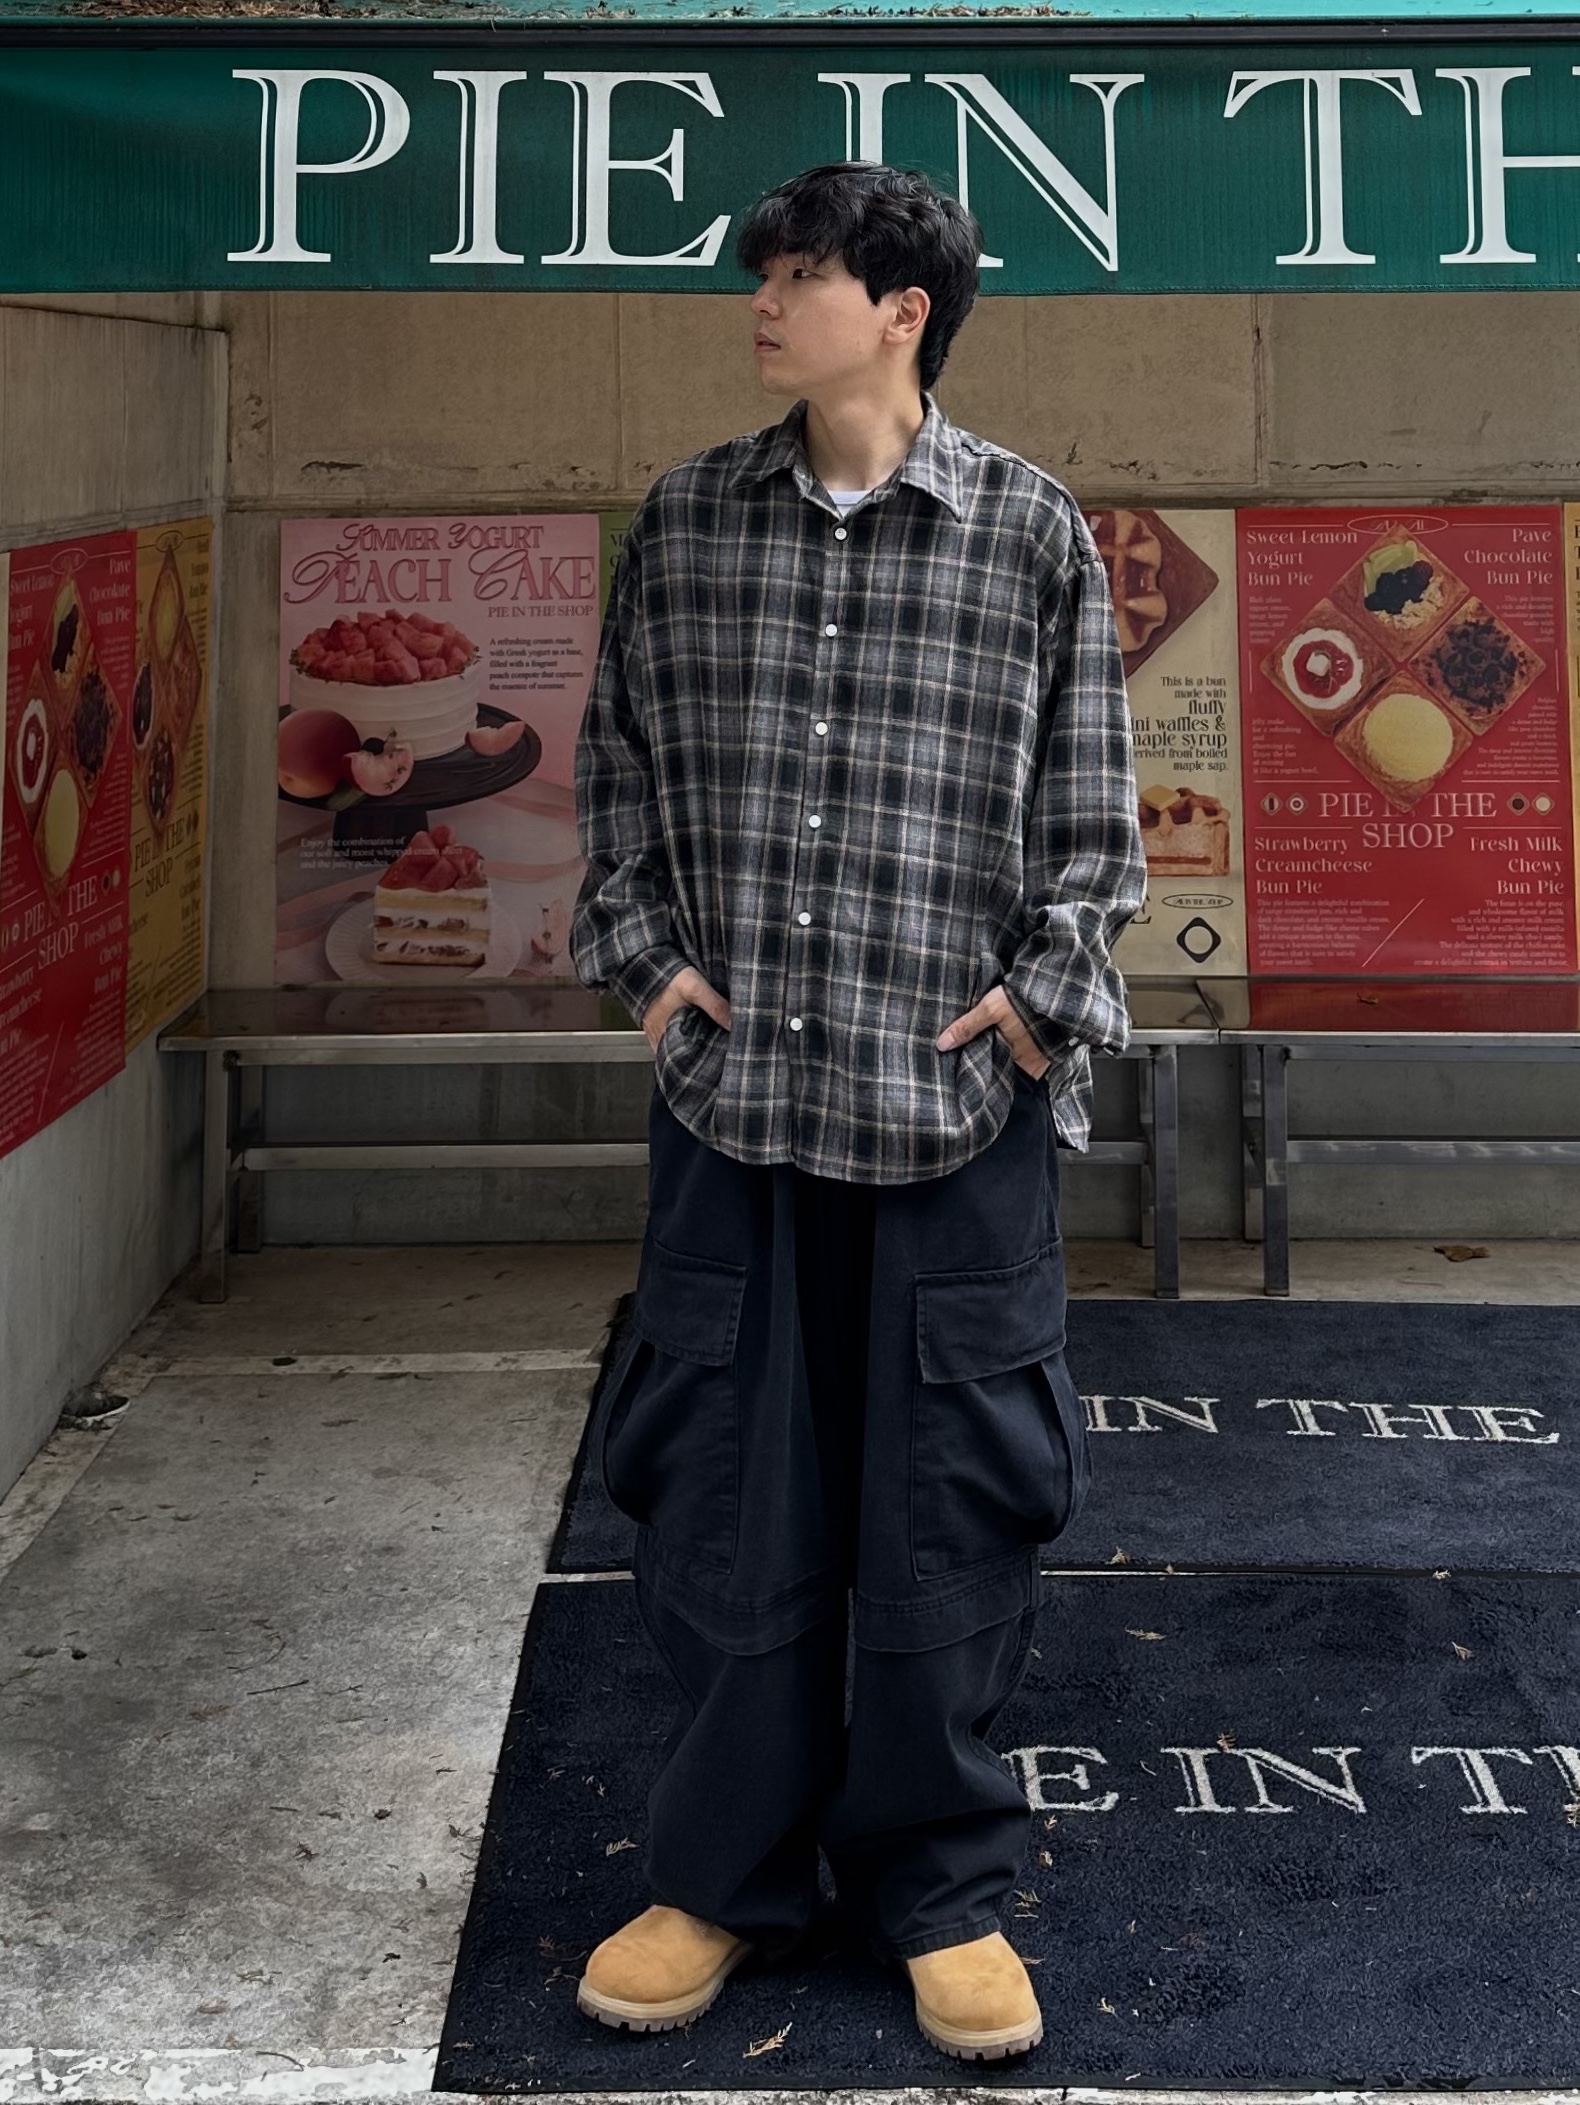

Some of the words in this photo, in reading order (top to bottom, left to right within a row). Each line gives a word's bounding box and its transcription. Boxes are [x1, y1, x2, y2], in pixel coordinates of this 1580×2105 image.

[227, 68, 732, 267] PIE
[335, 523, 441, 551] SUMMER
[447, 521, 545, 549] YOGURT
[1247, 530, 1294, 544] Sweet
[1301, 529, 1358, 545] Lemon
[1512, 527, 1553, 543] Pave
[1247, 551, 1304, 570] Yogurt
[1463, 547, 1553, 564] Chocolate
[283, 551, 453, 605] PEACH
[467, 546, 597, 601] CAKE
[1248, 571, 1281, 586] Bun
[1288, 571, 1314, 586] Pie
[1487, 569, 1520, 585] Bun
[1527, 569, 1554, 585] Pie
[487, 605, 510, 618] PIE
[511, 605, 527, 617] IN
[528, 605, 557, 617] THE
[556, 604, 594, 617] SHOP
[1161, 676, 1183, 687] This
[1185, 676, 1195, 687] is
[1196, 678, 1204, 687] a
[1206, 676, 1227, 687] bun
[1174, 688, 1203, 699] made
[1206, 688, 1227, 699] with
[1155, 716, 1210, 732] waffles
[1215, 714, 1227, 731] &
[1181, 733, 1228, 750] syrup
[1168, 748, 1194, 759] from
[1195, 748, 1228, 759] boiled
[1173, 761, 1206, 772] maple
[1207, 763, 1229, 773] sap.
[1318, 792, 1374, 818] PIE
[1429, 792, 1497, 818] THE
[300, 837, 325, 848] Enjoy
[327, 837, 341, 847] the
[1362, 822, 1455, 849] SHOP
[1470, 836, 1520, 852] Fresh
[1525, 836, 1563, 852] Milk
[1254, 836, 1348, 855] Strawberry
[1255, 857, 1373, 873] Creamcheese
[1508, 857, 1562, 877] Chewy
[1256, 879, 1290, 894] Bun
[1296, 879, 1324, 894] Pie
[1497, 879, 1532, 895] Bun
[1538, 879, 1565, 895] Pie
[23, 901, 46, 943] PIE
[67, 875, 99, 918] THE
[38, 922, 79, 970] SHOP
[1078, 1394, 1221, 1434] IN
[1255, 1398, 1561, 1445] THE
[1160, 1746, 1367, 1814] IN
